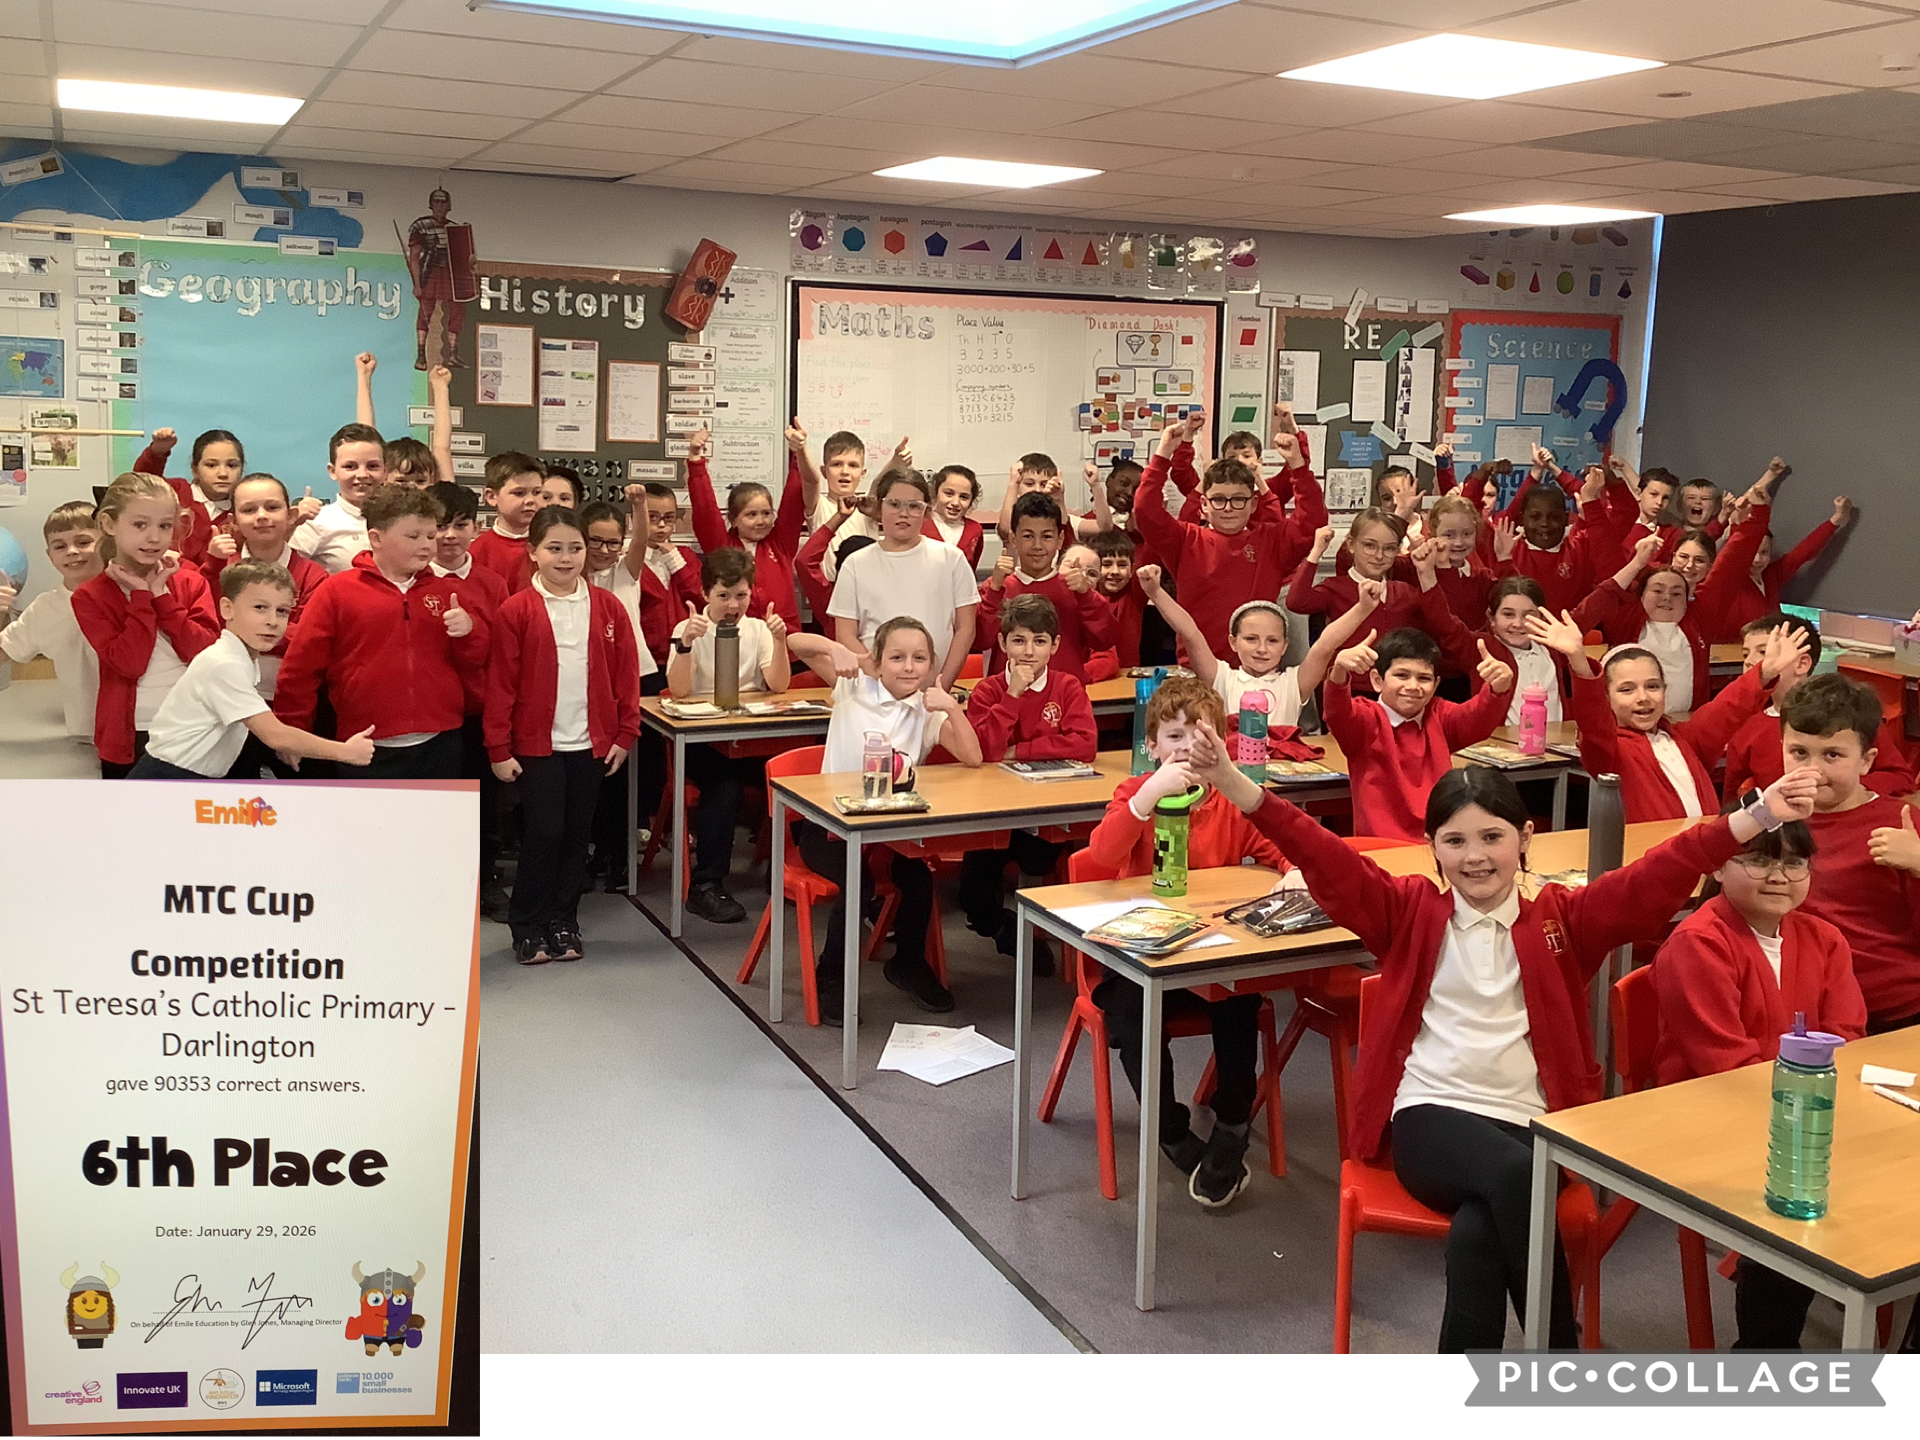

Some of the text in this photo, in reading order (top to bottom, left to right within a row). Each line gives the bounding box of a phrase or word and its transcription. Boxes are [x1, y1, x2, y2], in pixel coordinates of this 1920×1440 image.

[837, 213, 870, 222] heptagon
[880, 216, 908, 224] hexagon
[921, 219, 952, 228] pentagon
[730, 276, 758, 284] Addition
[139, 258, 402, 320] Geography
[480, 276, 646, 330] History
[818, 303, 936, 340] Maths
[956, 314, 1004, 328] Place Value
[1238, 316, 1260, 324] rhombus
[729, 332, 757, 340] Addition
[1344, 324, 1382, 350] RE
[1486, 332, 1593, 360] Science
[960, 348, 1013, 360] 3 2 3 5
[164, 884, 315, 922] MTC Cup
[130, 948, 344, 984] Competition
[13, 989, 44, 1014] St
[191, 992, 312, 1018] Catholic
[322, 995, 435, 1026] Primary
[162, 1032, 316, 1064] Darlington
[106, 1075, 366, 1094] gave 90353 correct answers.
[82, 1136, 389, 1188] 6th Place
[155, 1224, 316, 1240] Date: January 29, 2026
[230, 1319, 238, 1328] by
[240, 1319, 256, 1327] Glen
[258, 1318, 279, 1327] Jones,
[280, 1318, 314, 1328] Managing
[315, 1318, 342, 1326] Director
[362, 1372, 394, 1380] 10,000
[124, 1385, 181, 1394] Innovate UK
[273, 1382, 310, 1390] Microsoft
[45, 1390, 82, 1399] creative
[66, 1396, 102, 1406] england
